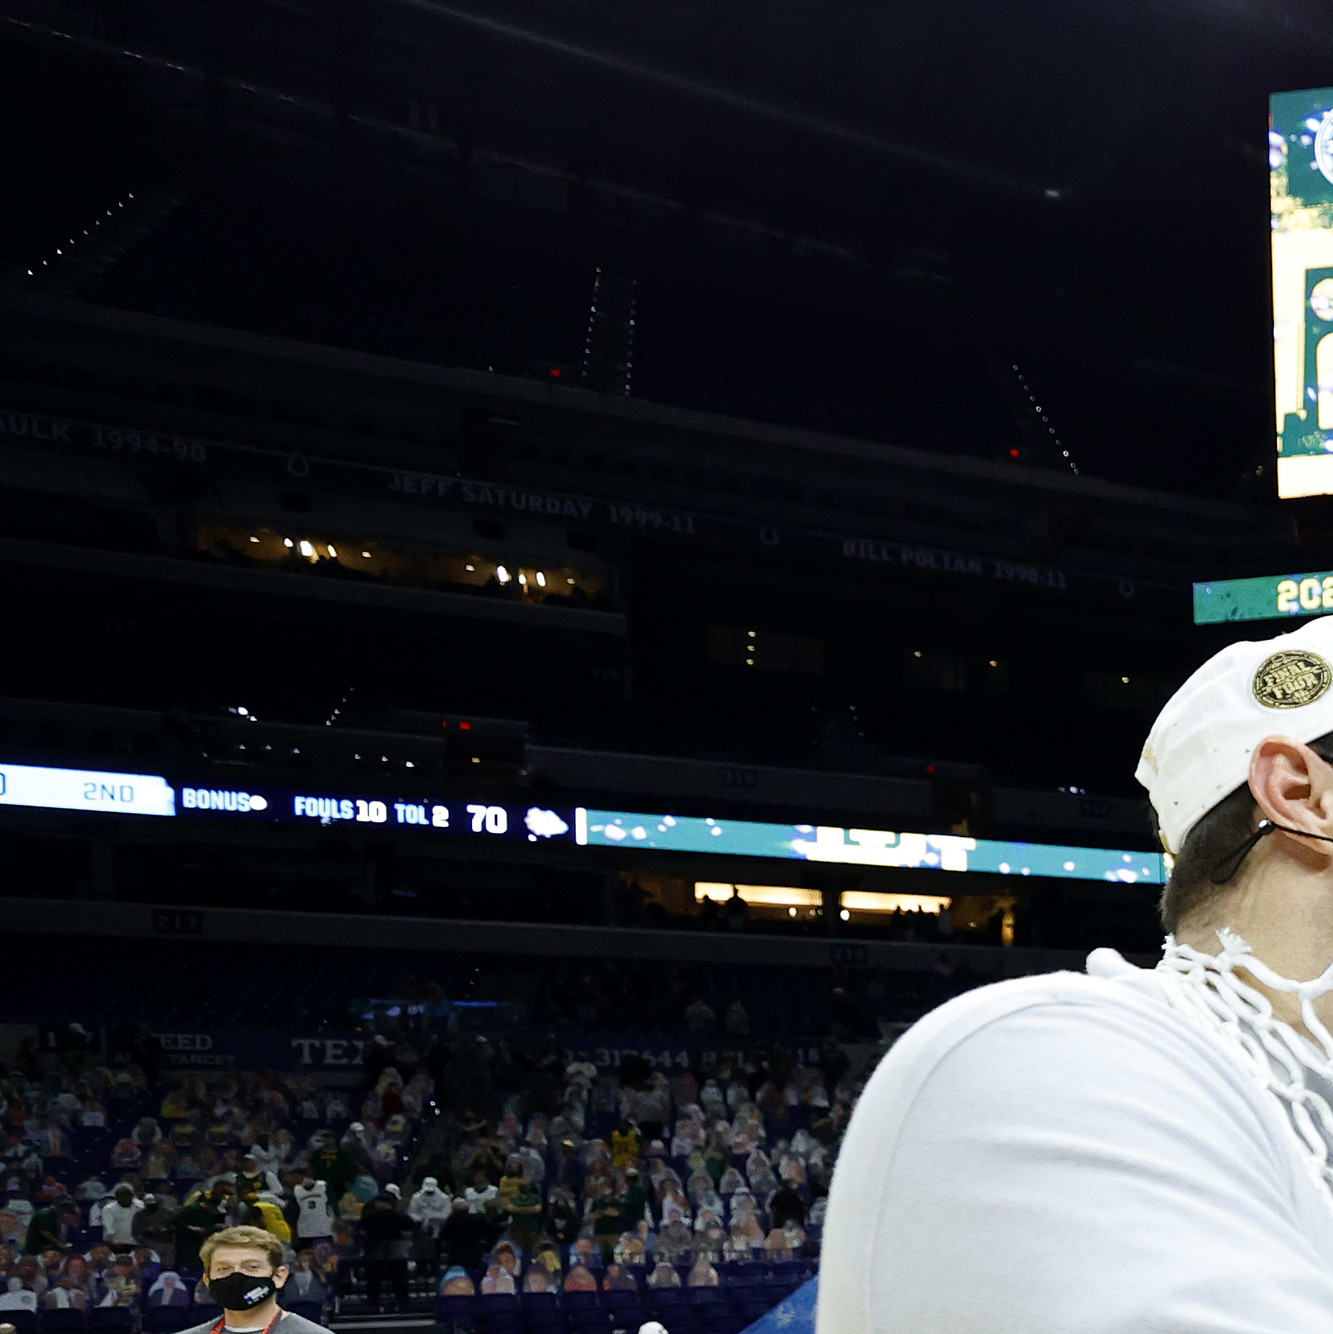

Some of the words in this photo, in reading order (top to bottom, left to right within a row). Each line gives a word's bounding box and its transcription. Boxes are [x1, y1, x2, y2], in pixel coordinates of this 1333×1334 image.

[387, 473, 452, 498] JEFF
[460, 484, 592, 519] SATURDAY
[1272, 672, 1319, 699] FOUR
[84, 783, 134, 802] 2ND
[183, 788, 250, 811] BONUS
[294, 796, 354, 819] FOULS
[356, 800, 387, 823] 10
[394, 803, 429, 825] TOL
[432, 806, 449, 827] 2
[467, 805, 508, 833] 70
